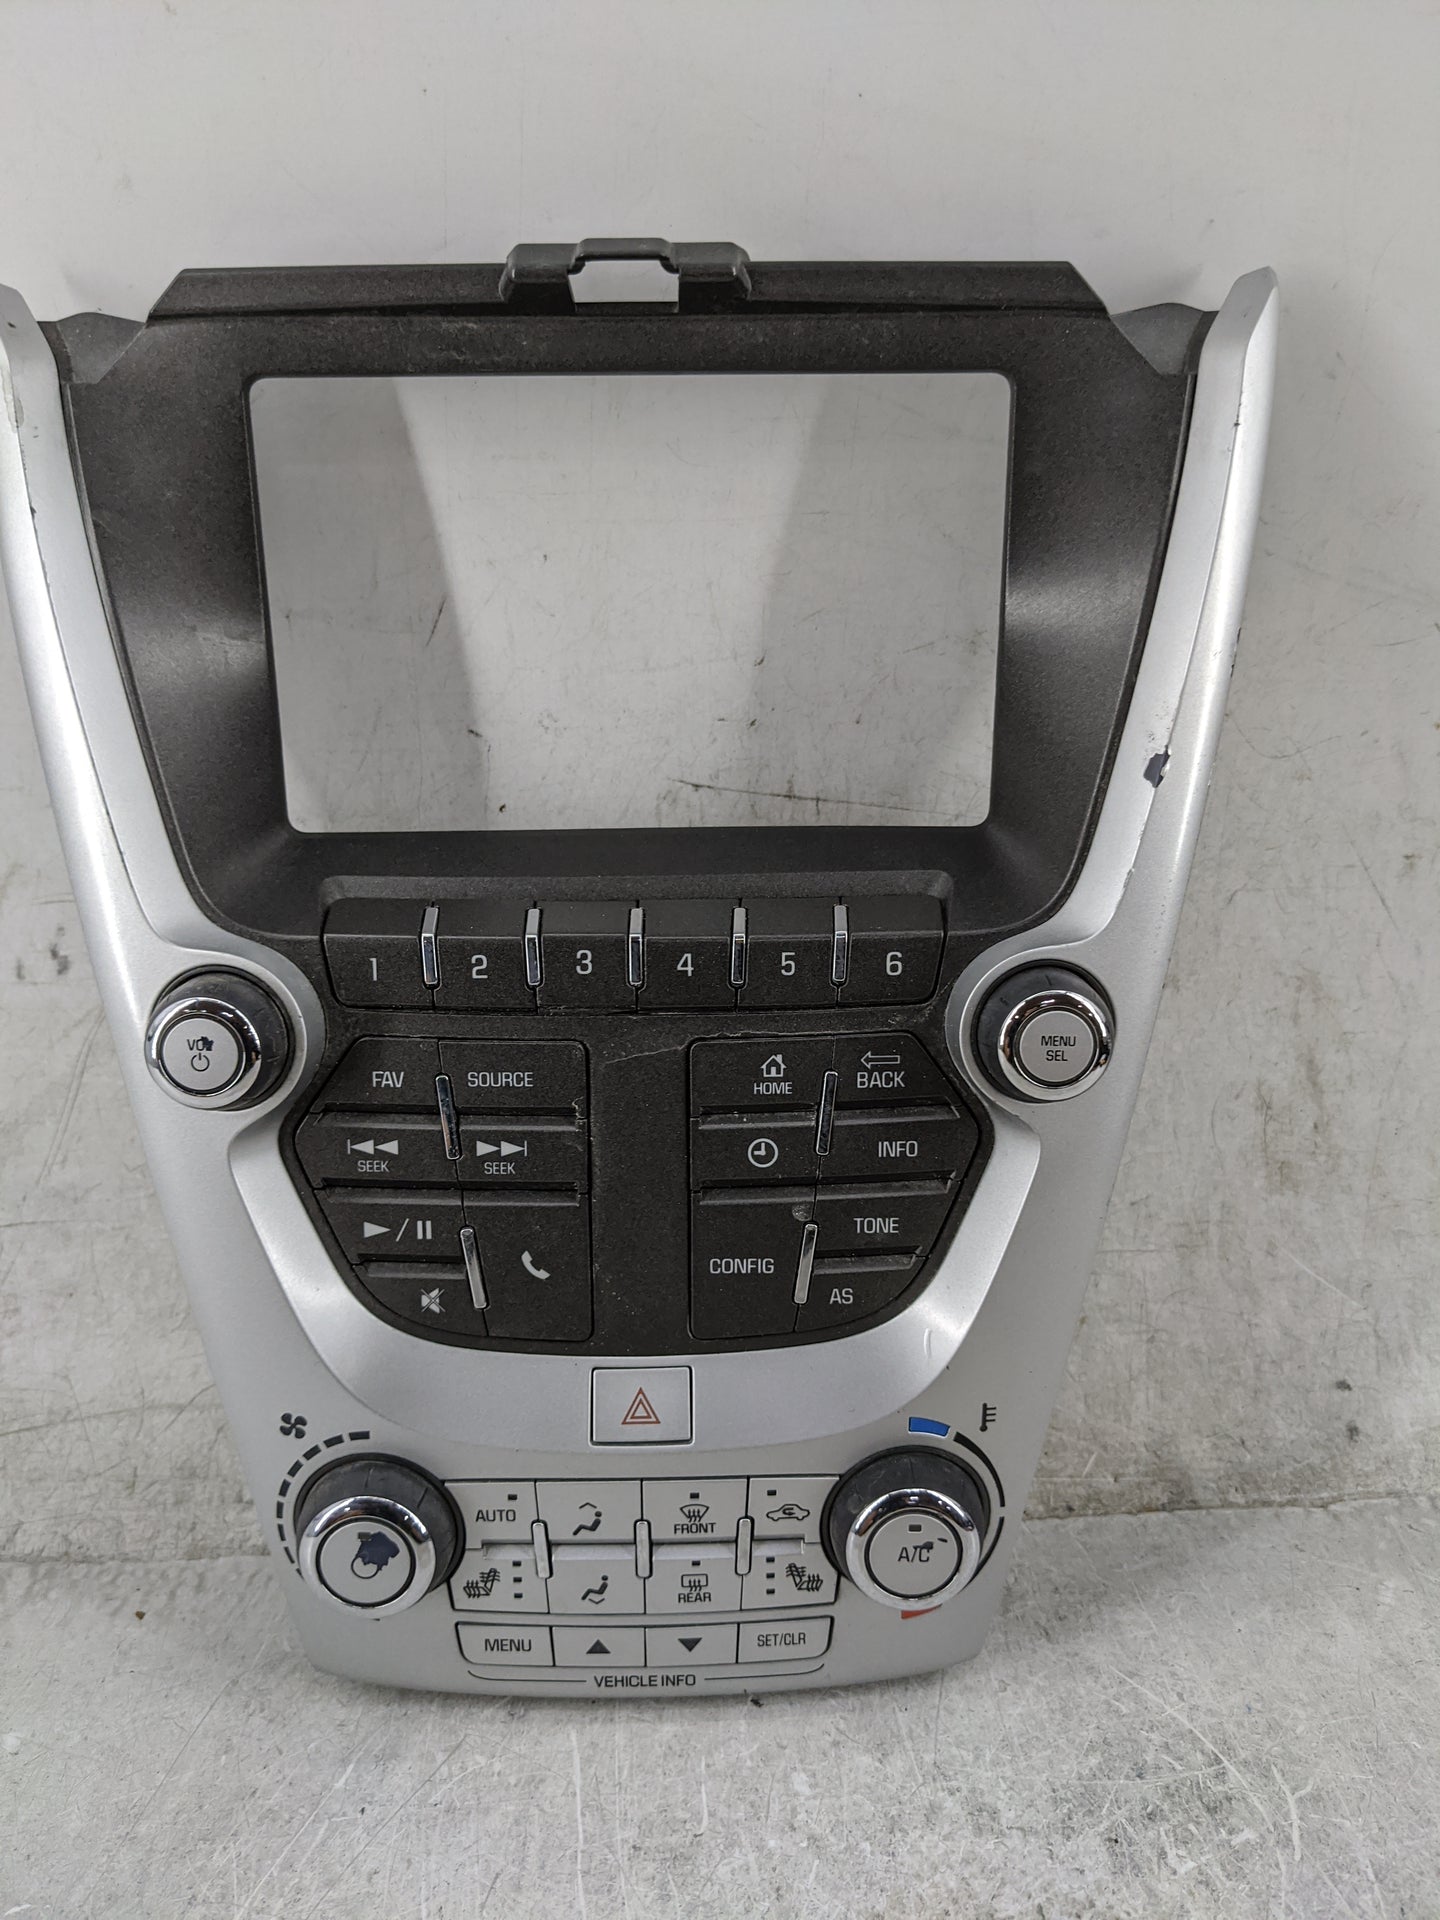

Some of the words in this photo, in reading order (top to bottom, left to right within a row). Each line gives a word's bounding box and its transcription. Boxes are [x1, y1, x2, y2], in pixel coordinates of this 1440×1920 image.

[369, 957, 379, 981] 1
[471, 954, 489, 979] 2
[575, 949, 593, 975] 3
[676, 953, 694, 977] 4
[780, 951, 796, 976] 5
[885, 951, 903, 975] 6
[187, 1037, 214, 1051] VO
[1041, 1035, 1076, 1047] MENU
[1046, 1050, 1068, 1062] SEL
[372, 1071, 404, 1088] FAV
[467, 1071, 534, 1088] SOURCE
[753, 1081, 793, 1095] HOME
[856, 1071, 905, 1089] BACK
[878, 1140, 918, 1158] INFO
[357, 1160, 390, 1173] SEEK
[483, 1162, 516, 1175] SEEK
[853, 1217, 900, 1234] TONE
[709, 1258, 775, 1275] CONFIG
[829, 1288, 854, 1305] AS
[475, 1509, 517, 1522] AUTO
[673, 1522, 717, 1535] FRONT
[897, 1545, 930, 1563] A/C
[677, 1592, 712, 1604] REAR
[484, 1638, 532, 1652] MENU
[757, 1632, 806, 1648] SET/CLR
[593, 1675, 658, 1688] VEHICLE
[661, 1674, 697, 1687] INFO
